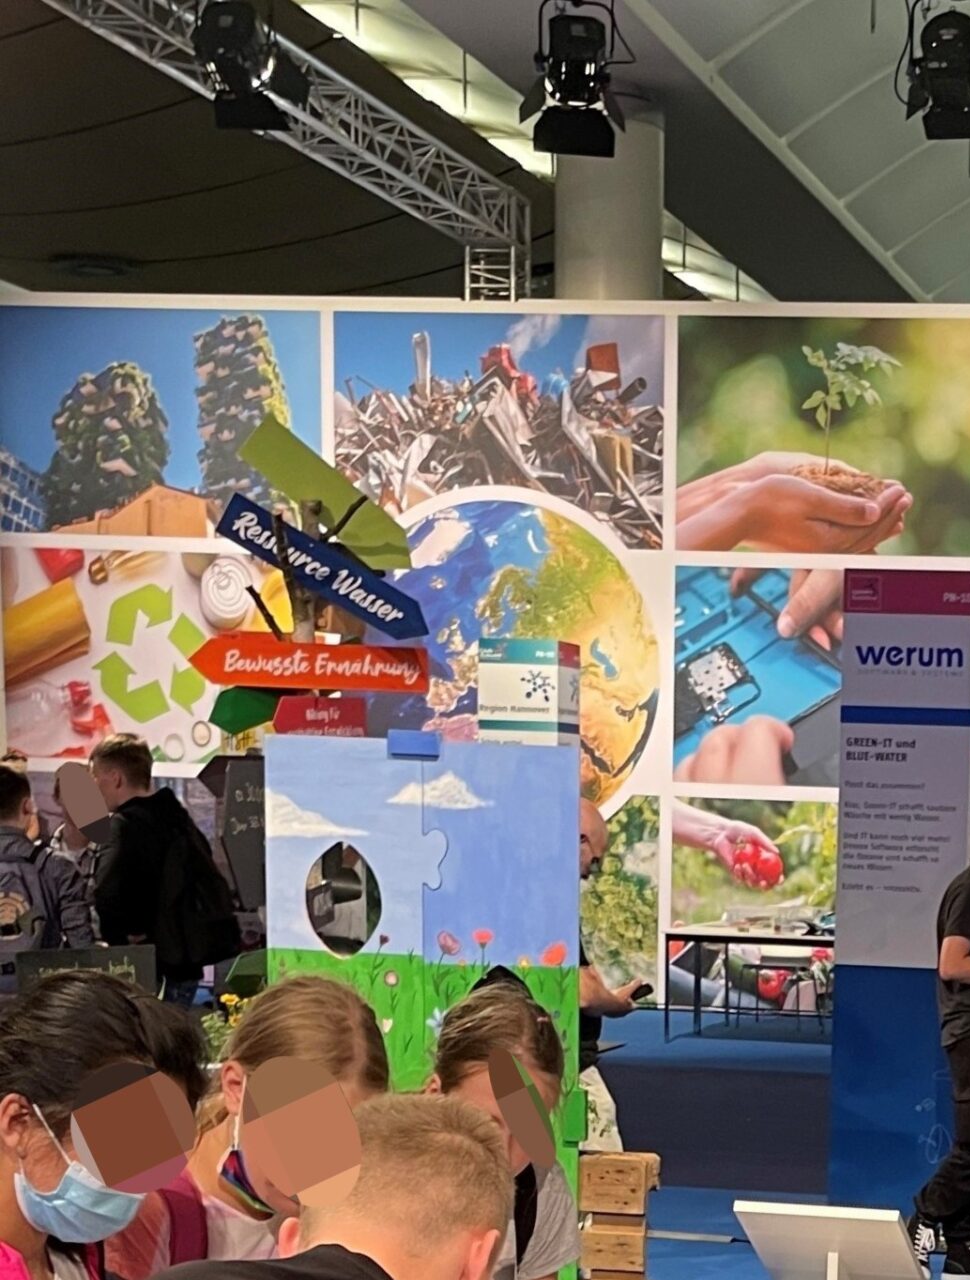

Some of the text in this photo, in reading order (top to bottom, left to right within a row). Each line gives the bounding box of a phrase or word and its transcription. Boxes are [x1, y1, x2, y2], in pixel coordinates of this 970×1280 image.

[231, 511, 404, 623] Ressurce Wasser
[224, 648, 421, 685] Bewusste Ernährung
[855, 645, 964, 668] werum
[846, 737, 916, 748] GREEN-IT und
[845, 751, 907, 762] BLUE-WATER
